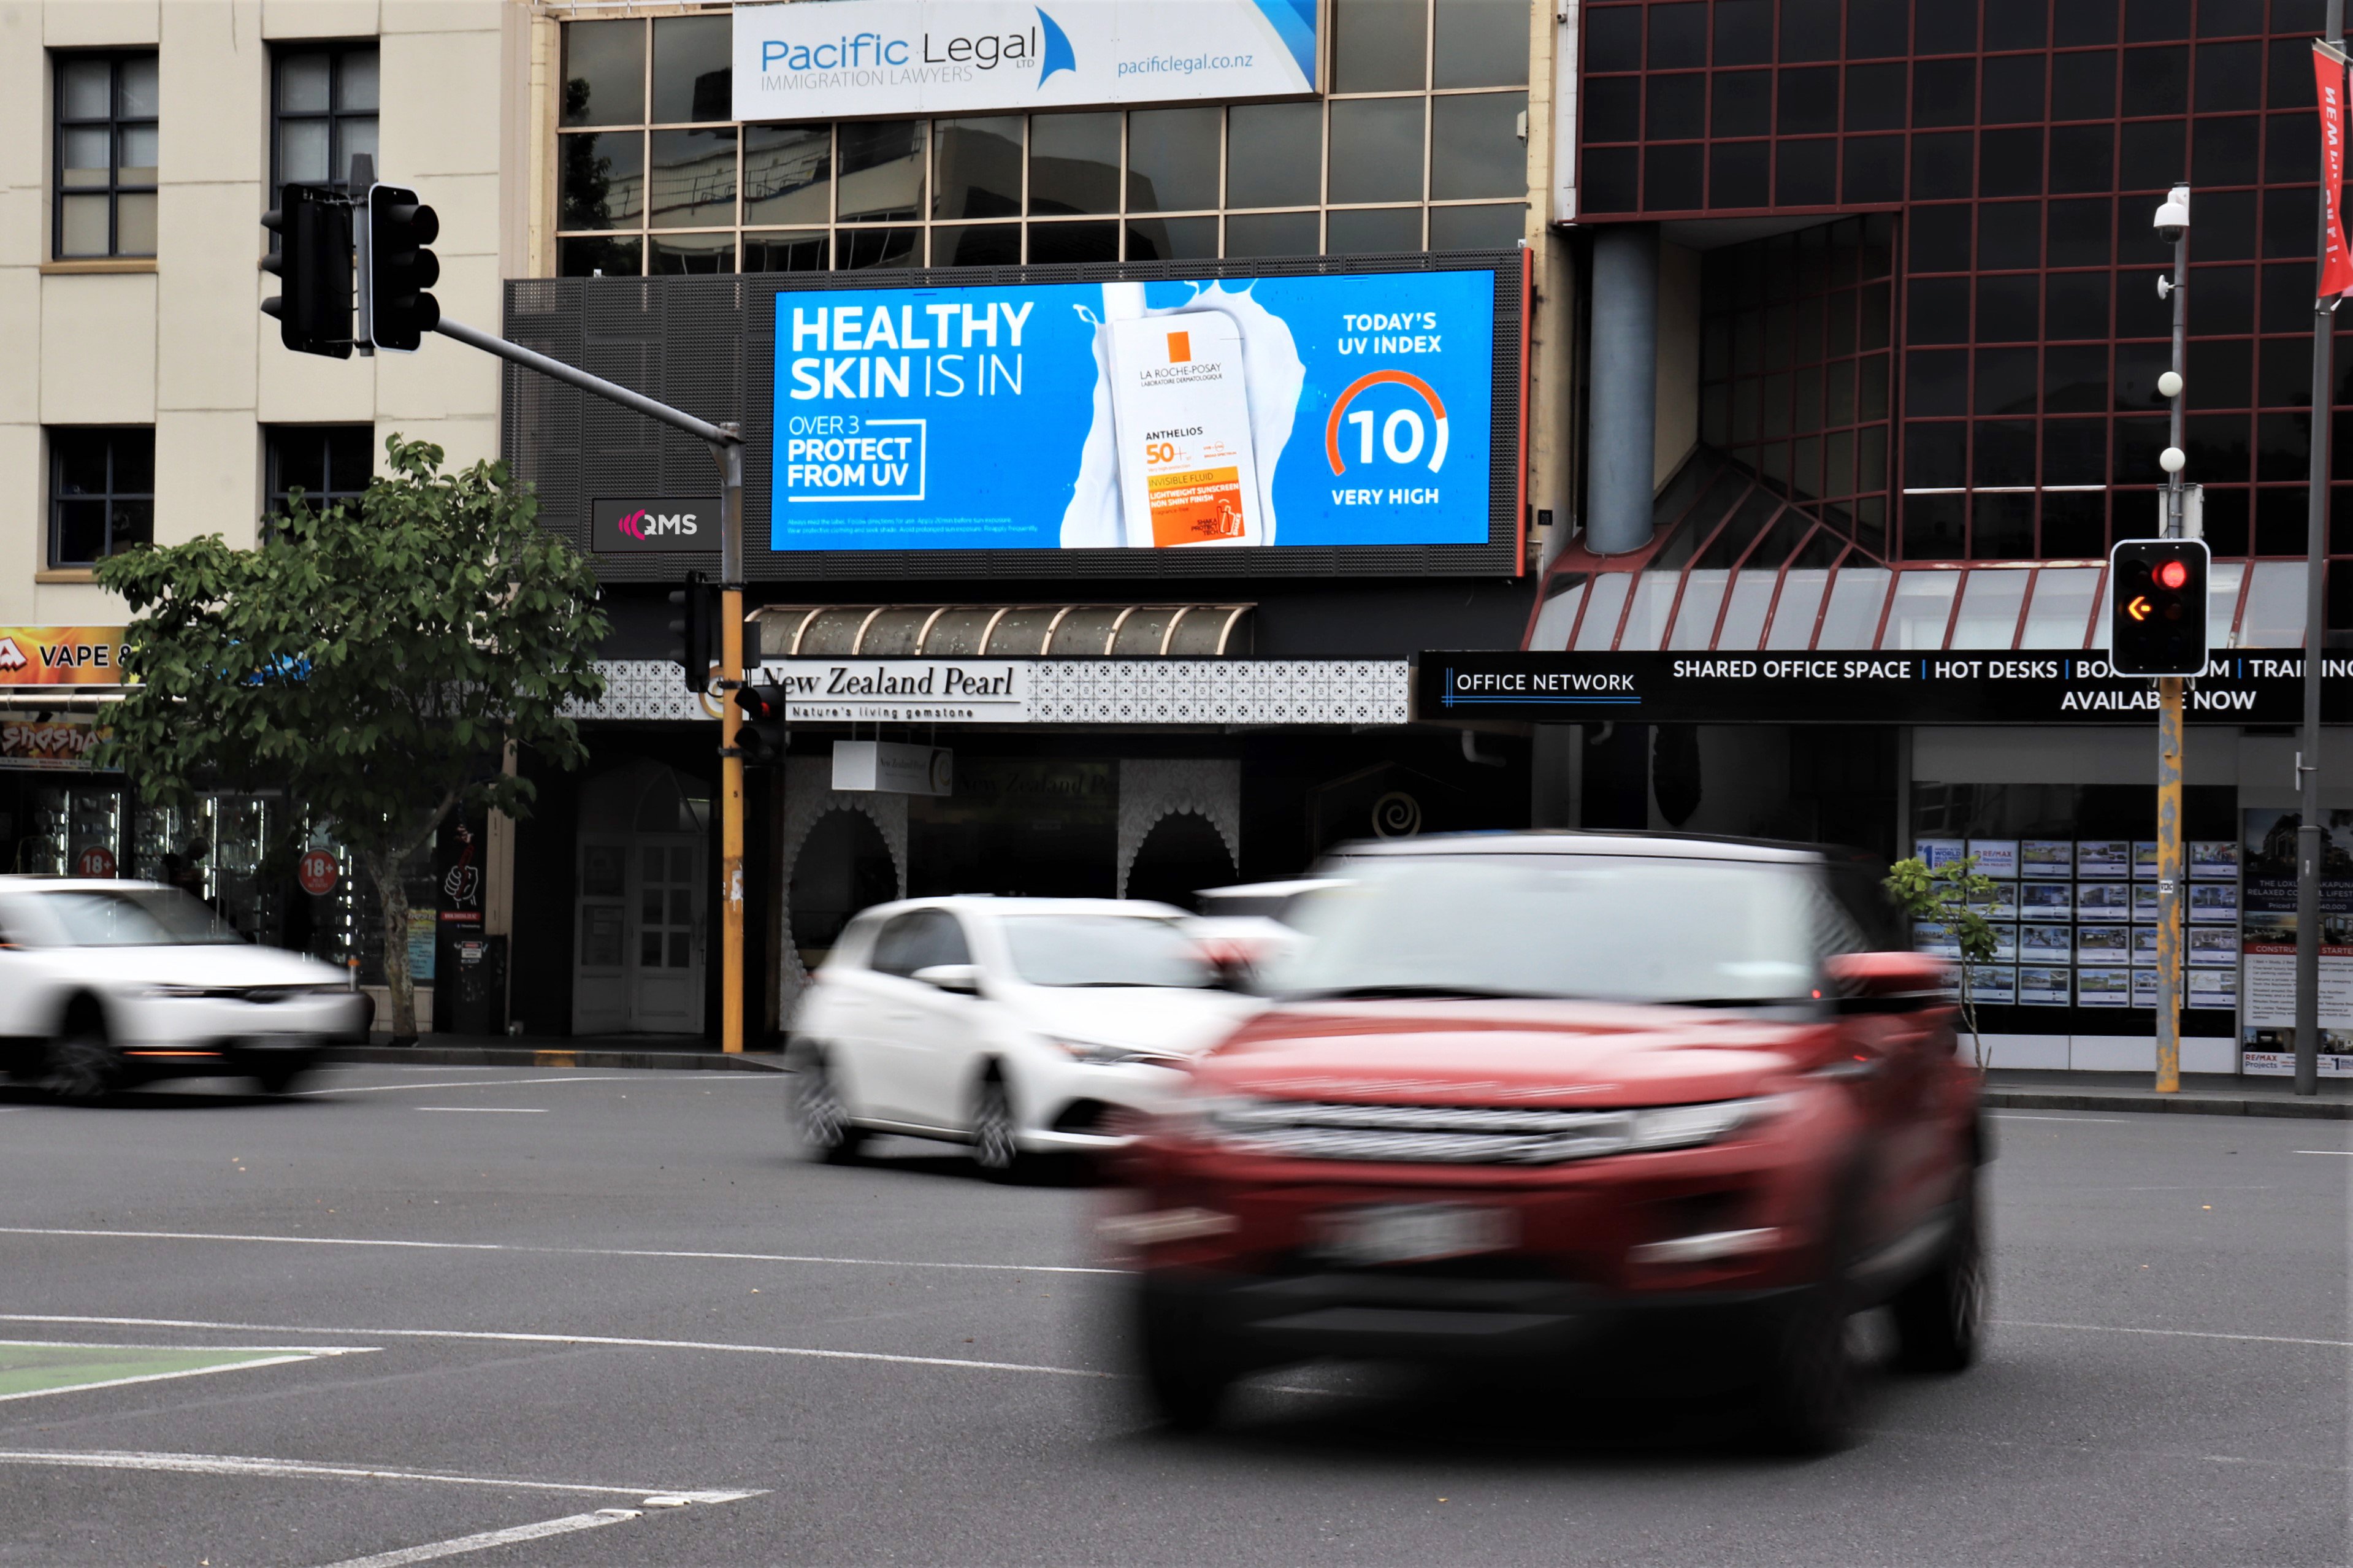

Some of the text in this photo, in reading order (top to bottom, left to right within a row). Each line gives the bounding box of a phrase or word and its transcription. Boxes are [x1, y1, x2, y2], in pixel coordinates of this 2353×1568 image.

[761, 26, 1036, 72] Pacific Legal LTD
[1118, 50, 1253, 78] pacificlegal.co.nz
[761, 65, 973, 92] IMMIGRATION LAWYERS
[792, 302, 1035, 351] HEALTHY
[1343, 312, 1437, 332] TODAY'S
[1338, 335, 1442, 355] UV INDEX
[790, 353, 1022, 400] SKIN IS IN
[1140, 362, 1222, 380] LA ROCHE-POSAY
[789, 415, 859, 435] OVER 3
[1146, 427, 1203, 440] ANTHELIOS
[1349, 409, 1425, 465] 10
[788, 437, 913, 462] PROTECT
[788, 462, 909, 488] FROM UV
[1149, 472, 1214, 487] INVISIBLE FLUID
[1150, 483, 1239, 500] LIGHTWEIGHT SUNSCREEN
[1168, 497, 1189, 506] SHINY
[1190, 494, 1214, 503] FINISH
[1331, 488, 1439, 505] VERY HIGH
[631, 512, 697, 537] QMS
[39, 644, 109, 668] VAPE
[1673, 660, 1758, 678] SHARED
[1762, 660, 1838, 678] OFFICE
[1843, 660, 1911, 678] SPACE
[1934, 660, 1983, 678] HOT
[1989, 660, 2058, 678] DESKS
[762, 667, 1014, 695] New Zealand Pearl
[1456, 674, 1634, 691] OFFICE NETWORK
[2194, 690, 2257, 709] NOW
[792, 706, 973, 719] Nature's living gemstone
[83, 855, 111, 874] 18+
[304, 859, 334, 878] 18+
